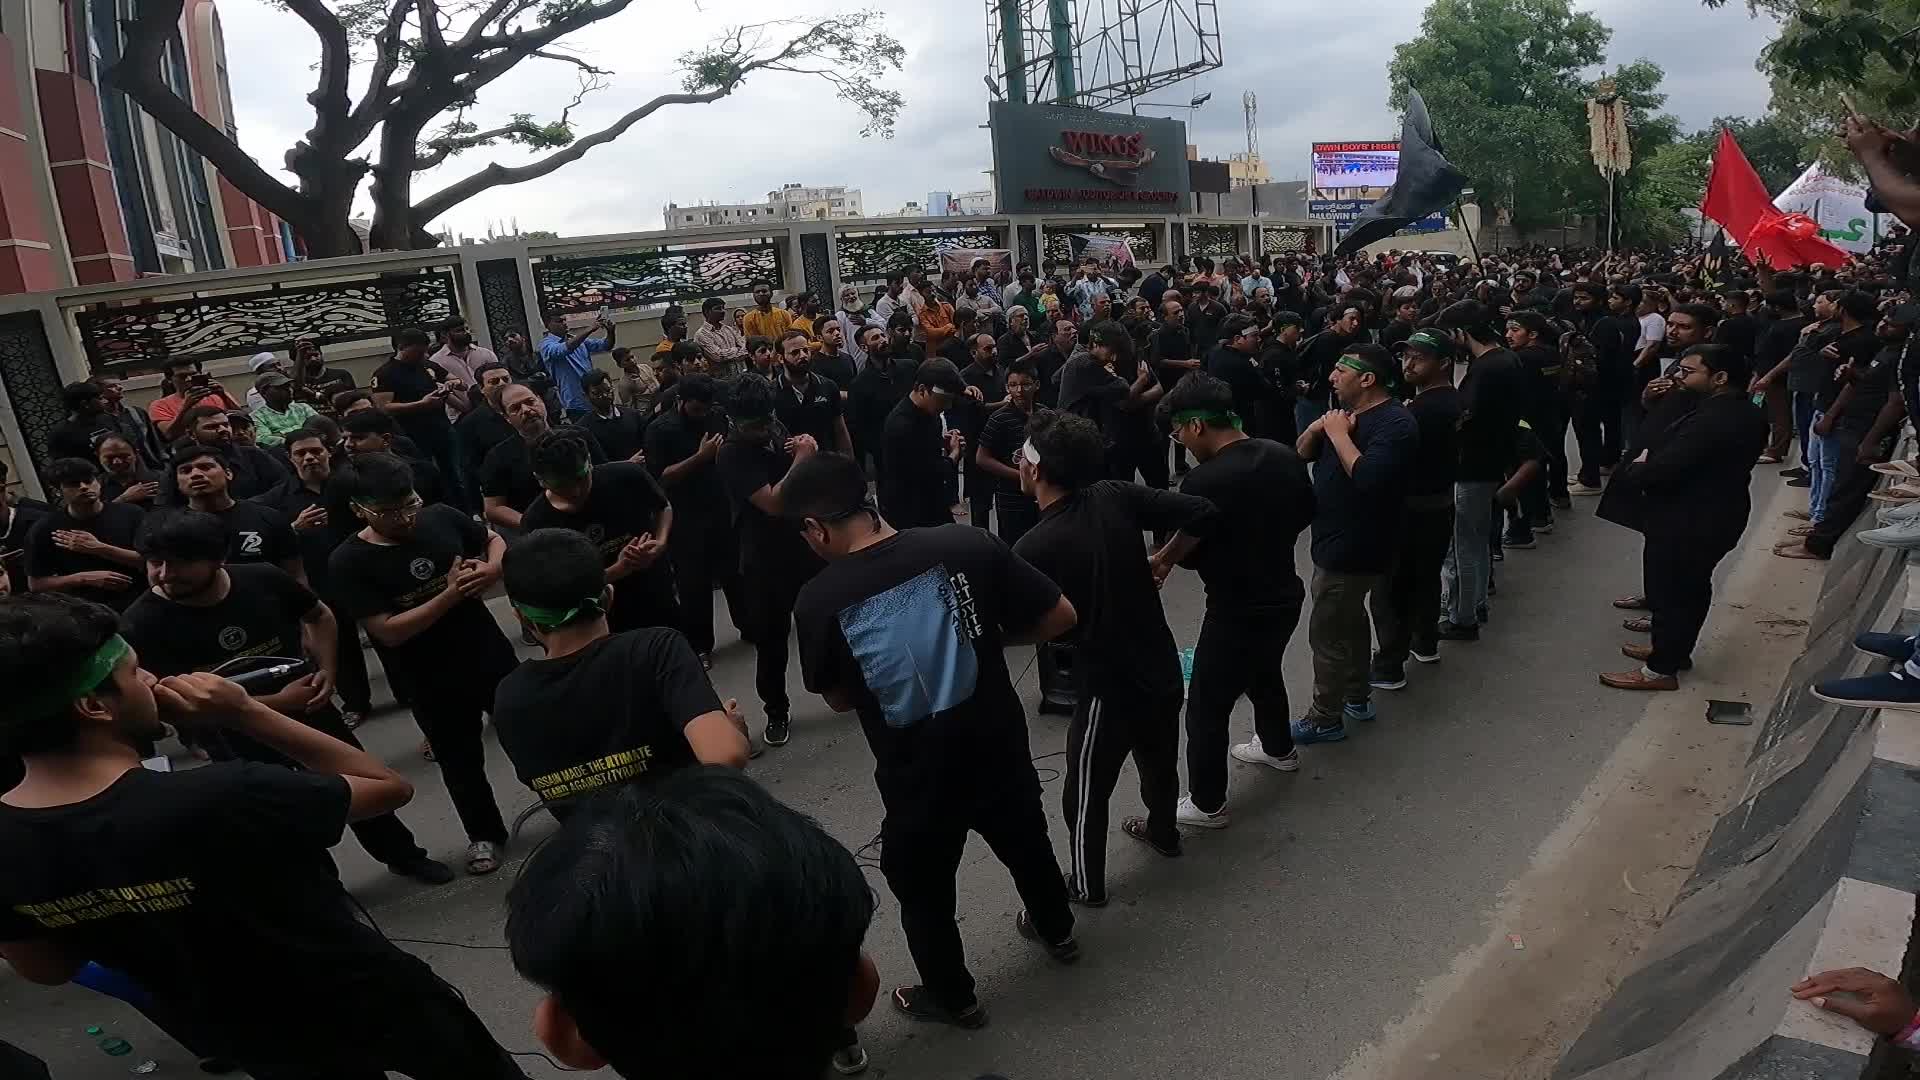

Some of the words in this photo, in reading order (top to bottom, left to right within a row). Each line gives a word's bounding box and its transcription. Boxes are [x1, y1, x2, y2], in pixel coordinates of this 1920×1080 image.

[1062, 130, 1143, 157] WINGS
[239, 531, 263, 552] 72
[560, 764, 588, 783] MADE
[587, 759, 606, 774] THE
[118, 877, 196, 901] ULTIMATE
